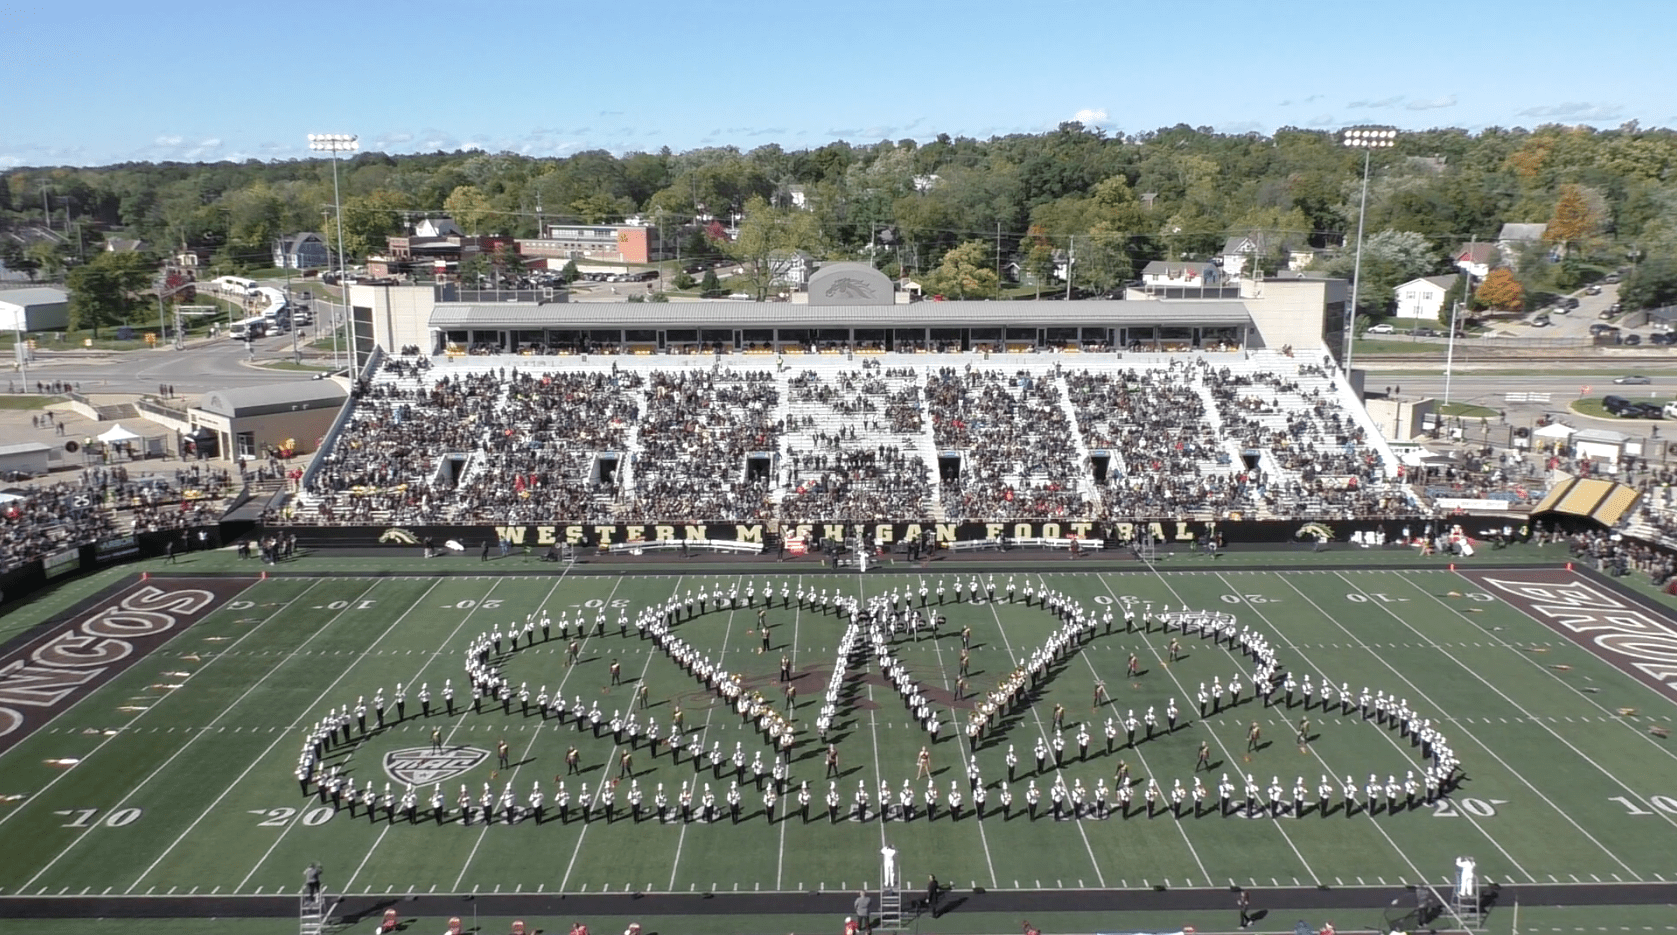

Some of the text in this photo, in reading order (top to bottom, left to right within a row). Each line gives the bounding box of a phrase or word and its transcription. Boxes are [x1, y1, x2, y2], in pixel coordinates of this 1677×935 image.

[73, 495, 90, 508] 25
[495, 525, 707, 545] WESTERN
[1220, 593, 1268, 604] 20
[1346, 592, 1398, 603] 10
[327, 599, 377, 610] 10
[456, 599, 505, 609] 20
[387, 758, 475, 770] MAC
[1423, 797, 1497, 817] 20
[60, 807, 142, 828] 10
[256, 807, 335, 827] 20
